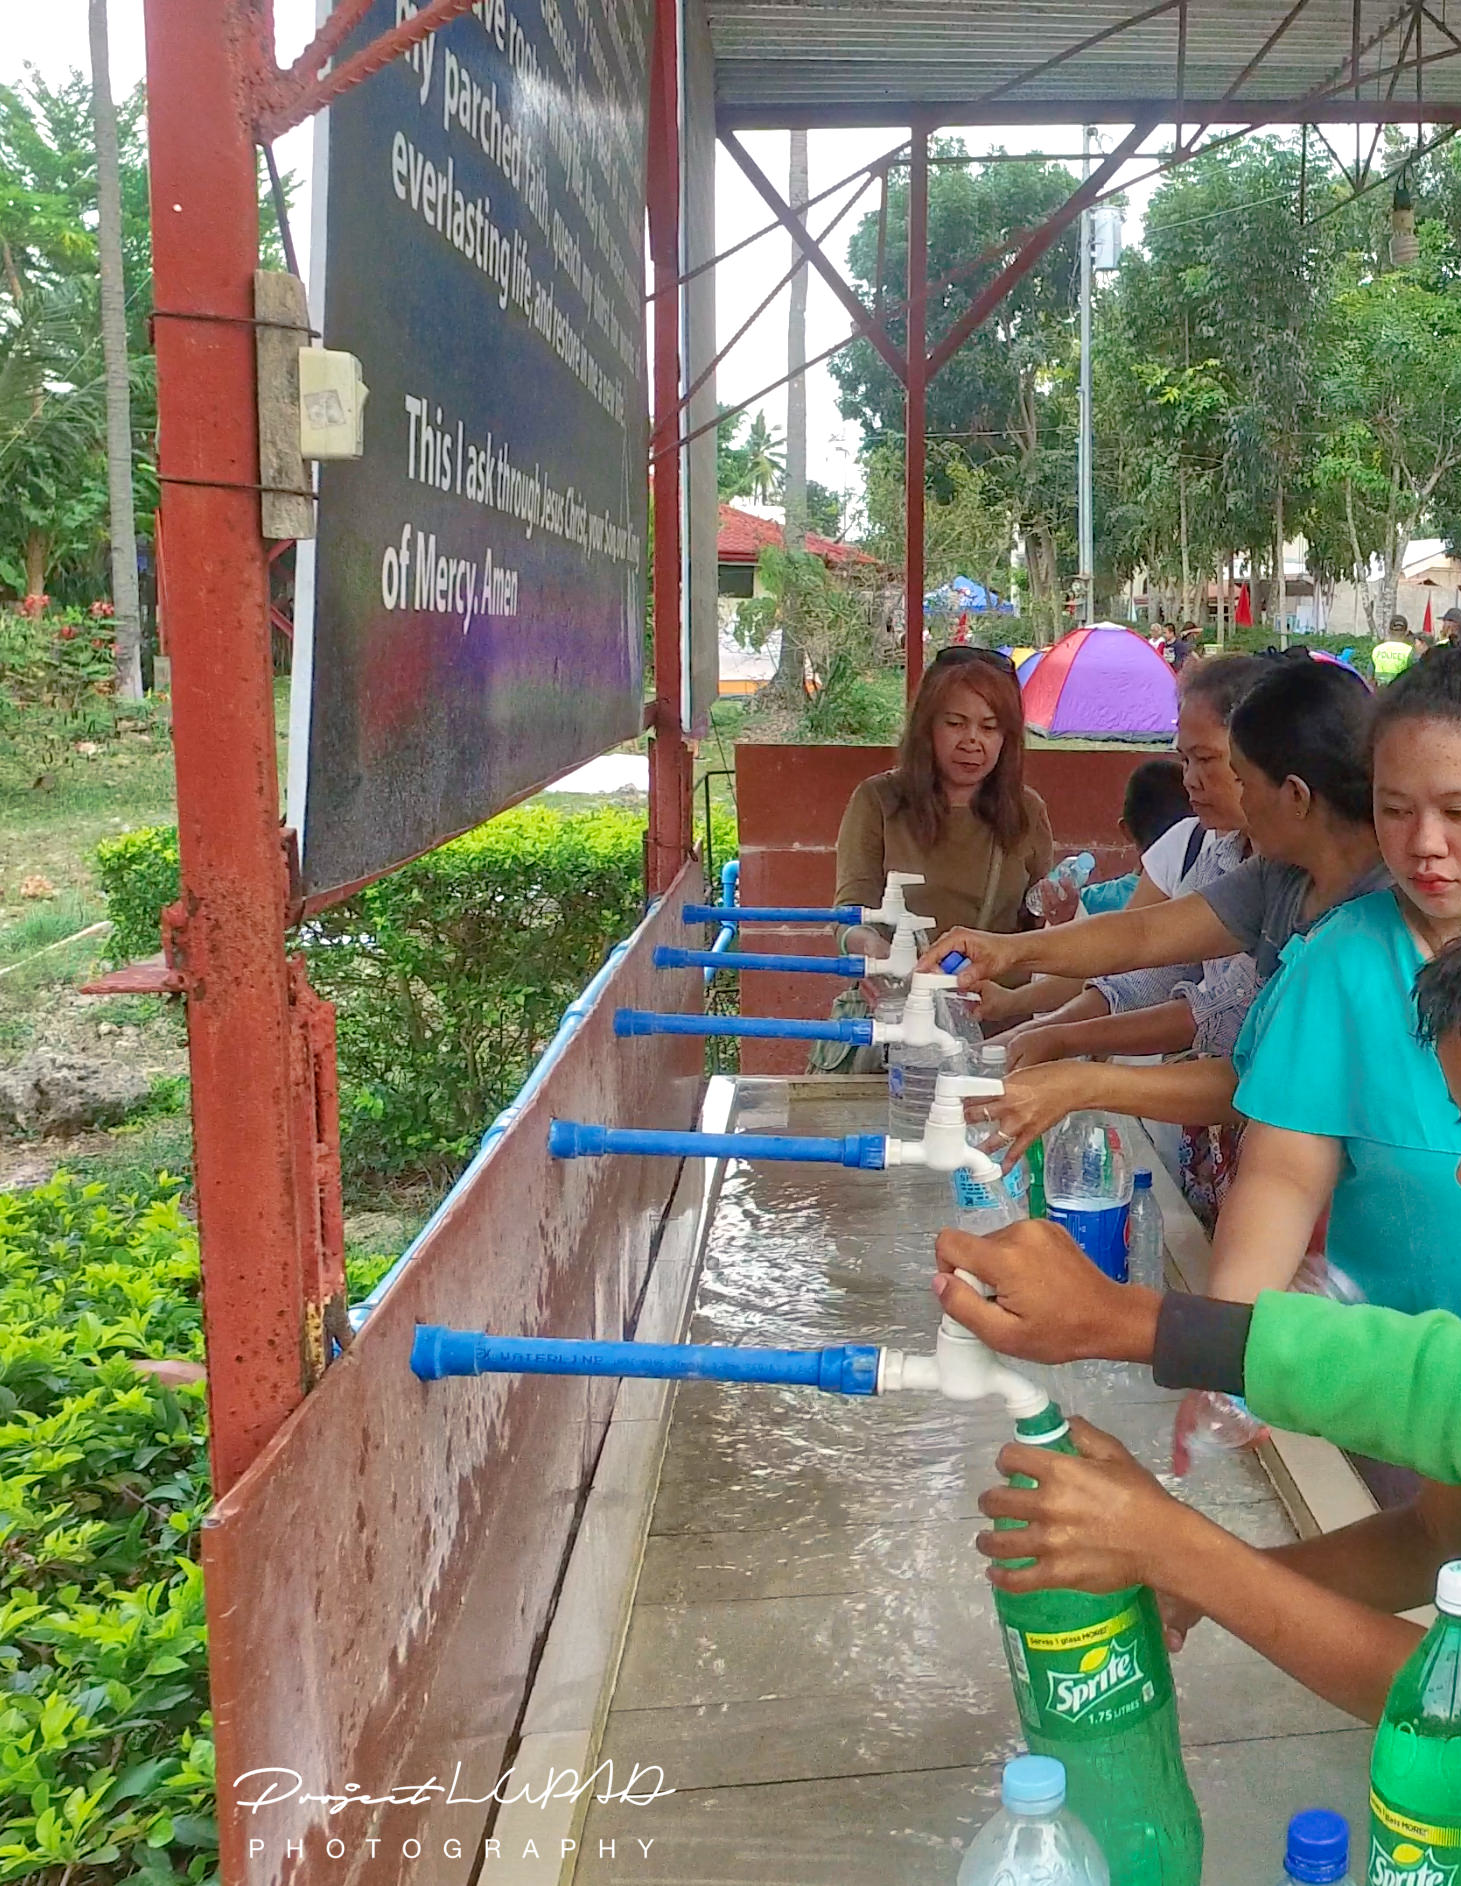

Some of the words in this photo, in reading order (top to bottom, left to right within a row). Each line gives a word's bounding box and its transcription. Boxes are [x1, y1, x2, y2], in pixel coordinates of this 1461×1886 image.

[444, 47, 521, 191] parched
[525, 135, 550, 248] faith,
[553, 207, 581, 292] quench
[391, 130, 511, 310] everlasting
[512, 229, 533, 329] life,
[533, 281, 554, 341] and
[553, 302, 580, 377] restore
[580, 331, 587, 387] in
[587, 353, 598, 398] me
[602, 373, 615, 417] new
[405, 394, 452, 492] This
[456, 420, 464, 495] I
[466, 431, 495, 508] ask
[496, 442, 540, 541] through
[541, 472, 565, 536] Jesus
[565, 486, 588, 551] Christ,
[587, 512, 604, 561] your
[382, 522, 412, 611] of
[414, 530, 478, 635] Mercy.
[481, 547, 518, 617] Amen
[1056, 1652, 1132, 1713] Sprite
[1089, 1709, 1113, 1725] 1.75
[1113, 1699, 1140, 1718] LITRES
[1372, 1856, 1444, 1886] Sprite
